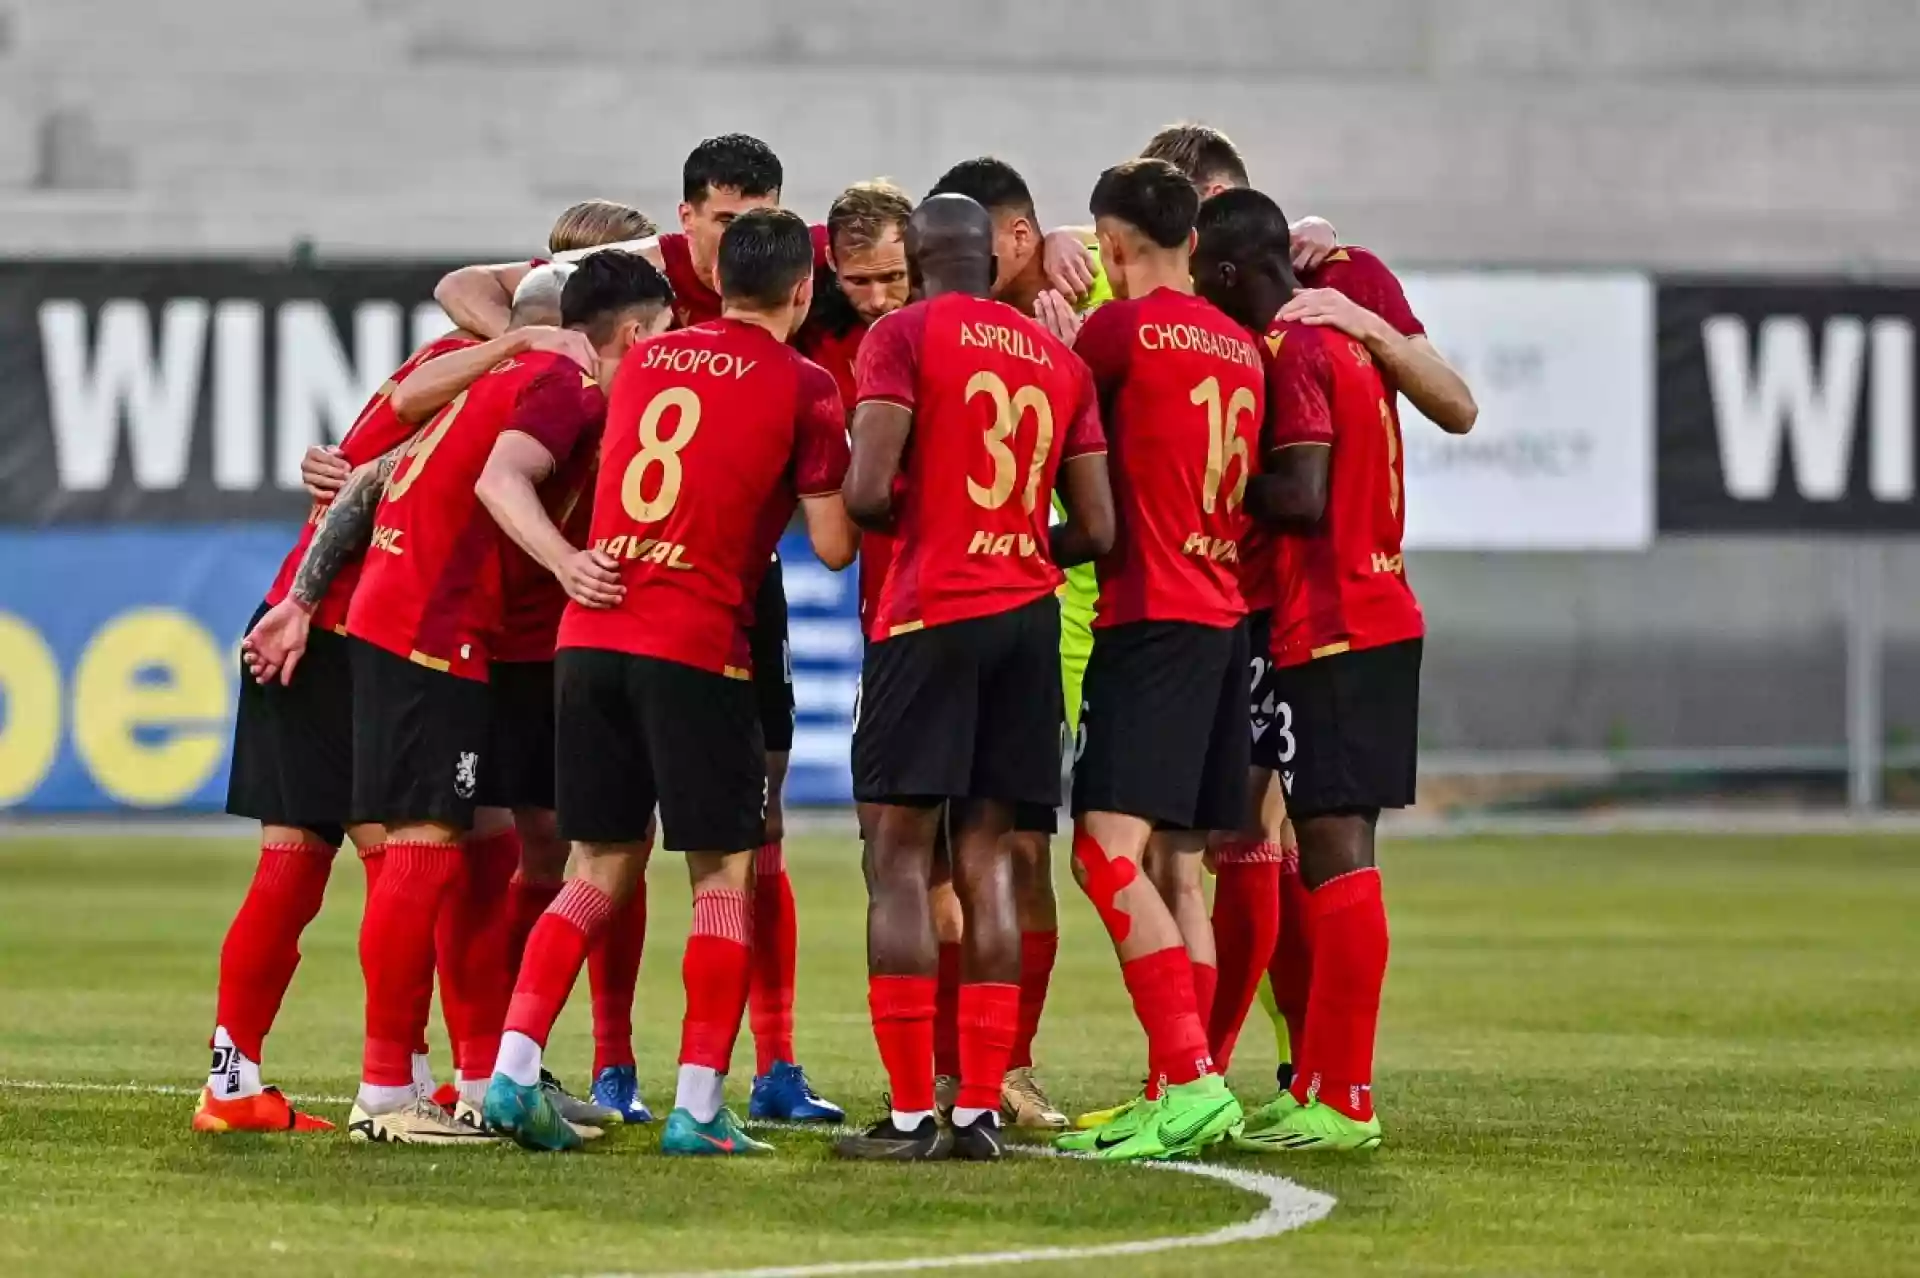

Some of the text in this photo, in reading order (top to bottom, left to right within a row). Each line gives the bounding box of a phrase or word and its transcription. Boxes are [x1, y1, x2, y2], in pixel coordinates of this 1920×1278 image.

[640, 344, 758, 380] SHOPOV
[960, 320, 1054, 371] ASPRILLA
[1138, 323, 1255, 368] CHORBADZHI
[36, 297, 459, 493] WIN
[1702, 312, 1915, 501] WI
[620, 386, 702, 524] 8
[1189, 375, 1256, 516] 16
[966, 530, 1040, 558] HAV
[1274, 701, 1297, 763] 3
